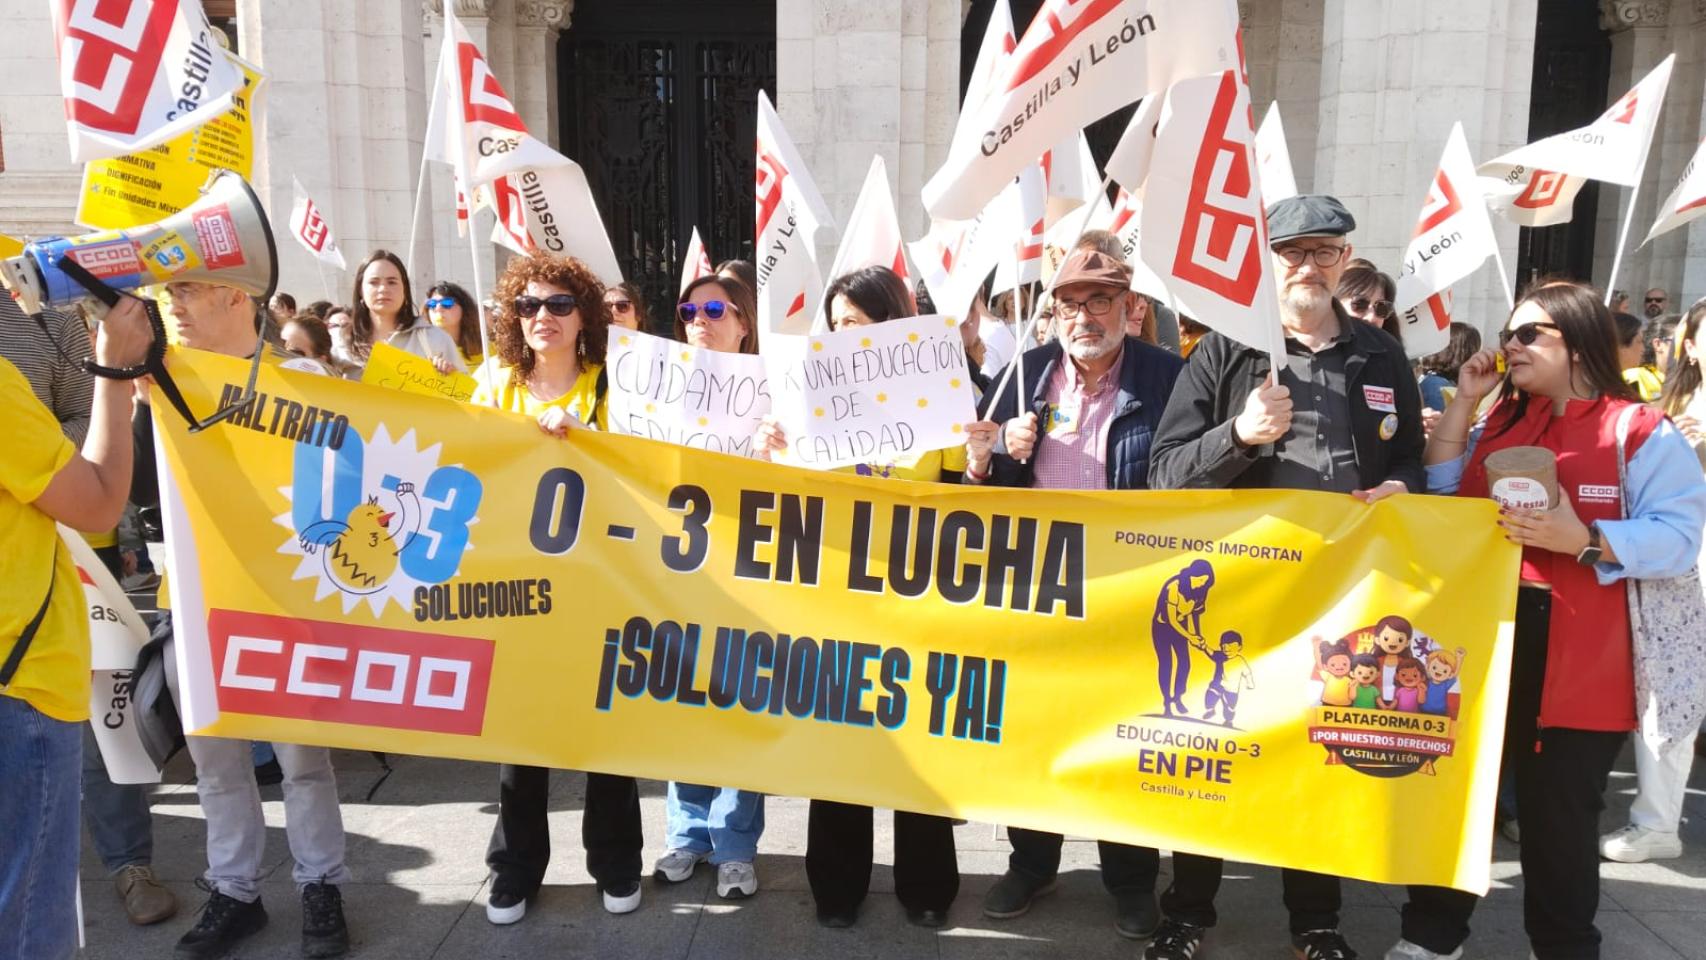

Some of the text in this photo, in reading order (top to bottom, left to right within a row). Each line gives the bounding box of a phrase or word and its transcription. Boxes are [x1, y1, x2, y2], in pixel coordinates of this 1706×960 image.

[981, 13, 1157, 157] Castilla y León
[521, 170, 564, 252] Castilla
[778, 215, 797, 238] Le
[82, 246, 132, 264] CCOO
[1406, 231, 1463, 274] y León
[803, 356, 848, 391] UNA
[217, 383, 349, 451] MALTRATO
[832, 391, 863, 421] DE
[1581, 486, 1613, 496] CCOO
[529, 467, 1086, 620] 0 - 3 EN LUCHA
[1115, 531, 1303, 563] PORQUE NOS IMPORTAN
[414, 578, 552, 622] SOLUCIONES
[220, 635, 472, 712] CCOO
[595, 616, 1007, 744] ¡SOLUCIONES YA!
[1116, 724, 1219, 753] EDUCACIÓN
[1323, 711, 1446, 733] PLATAFORMA 0-3
[1312, 731, 1451, 754] ¡POR NUESTROS DERECHOS!
[1343, 748, 1420, 764] CASTILLA Y LEÓN
[1138, 748, 1233, 784] EN PIE
[1141, 781, 1226, 803] Castilla y León
